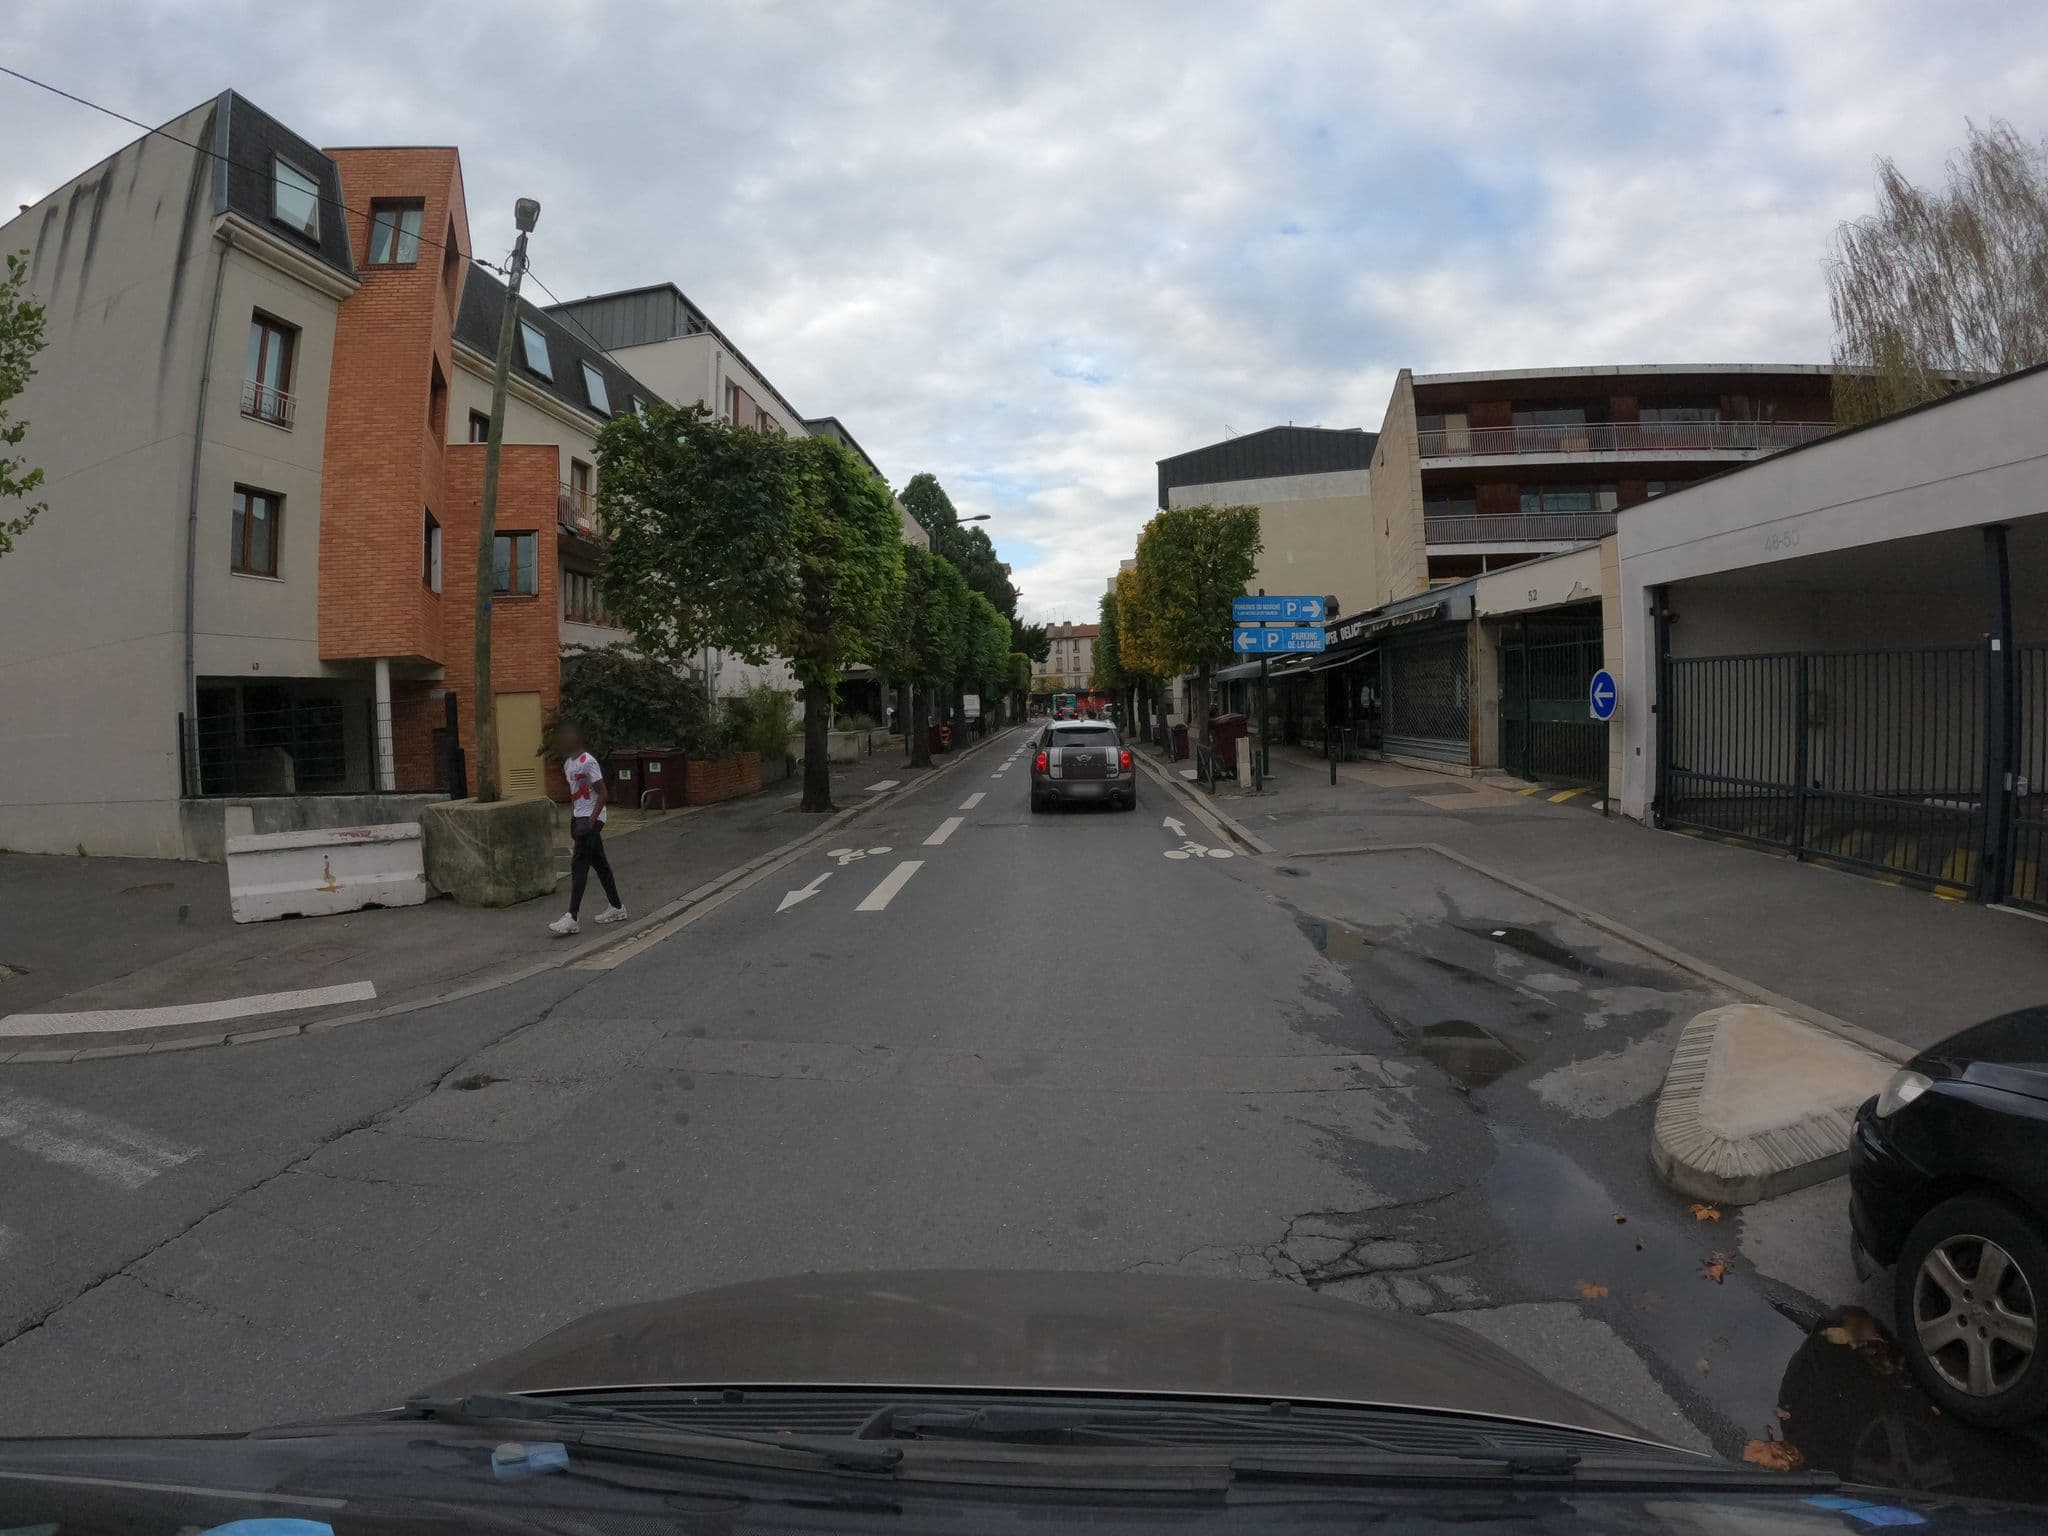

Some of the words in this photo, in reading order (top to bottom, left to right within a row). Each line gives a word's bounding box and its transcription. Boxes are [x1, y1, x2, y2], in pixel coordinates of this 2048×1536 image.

[1286, 602, 1297, 616] P
[1267, 633, 1279, 648] P
[1291, 632, 1318, 641] PARKING
[1287, 641, 1296, 649] DE
[1297, 641, 1305, 649] LA
[1306, 641, 1321, 649] GARE
